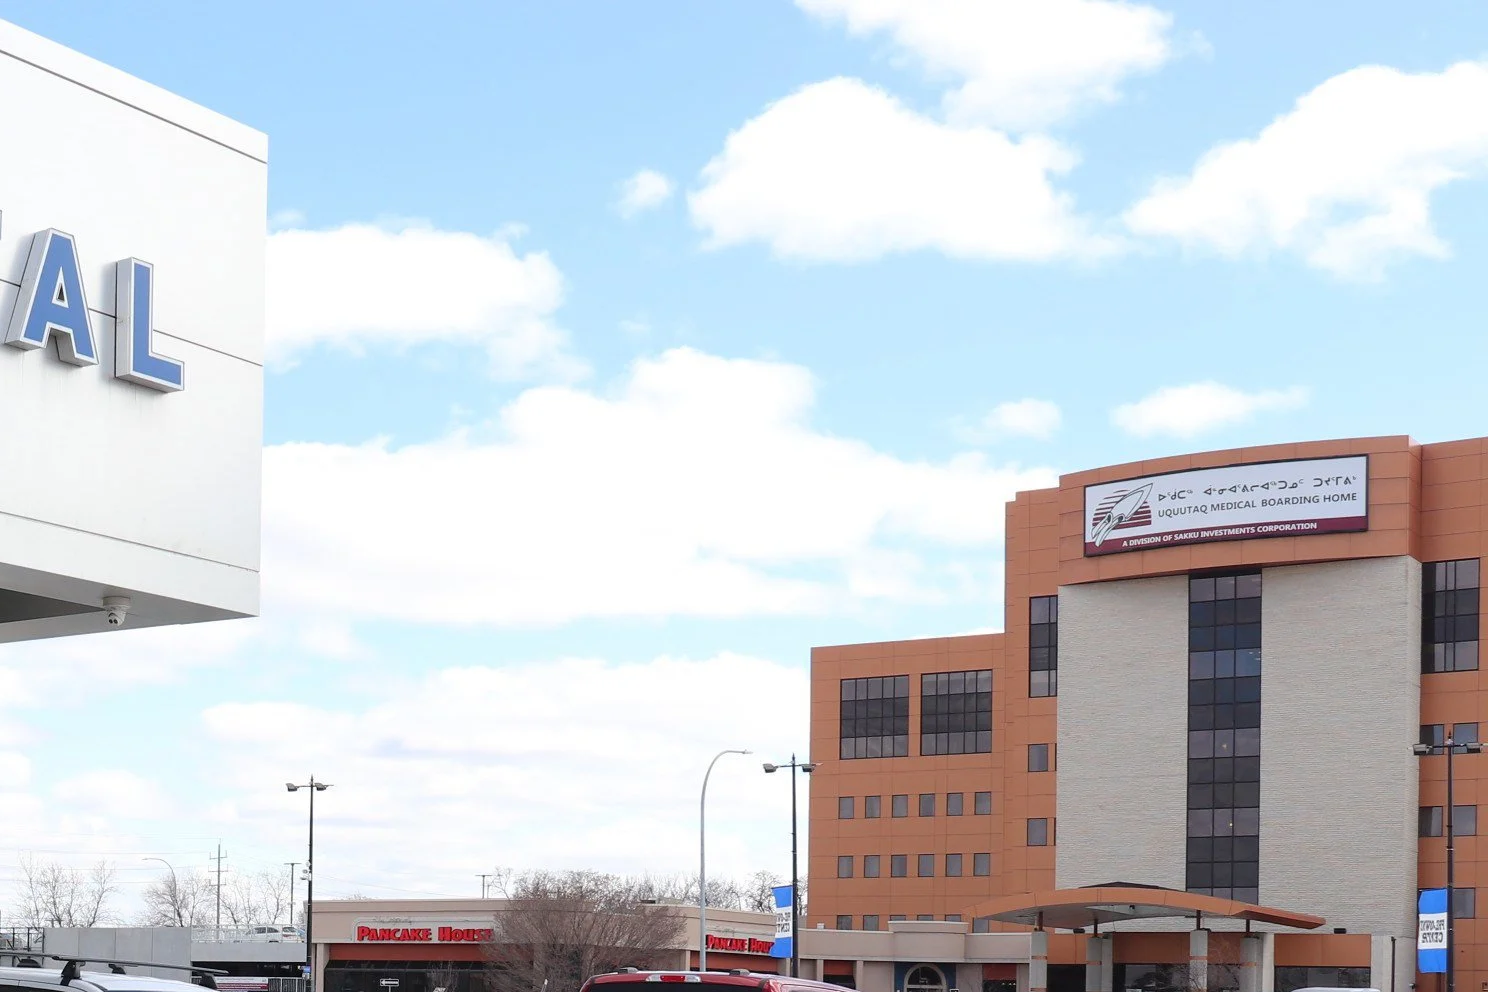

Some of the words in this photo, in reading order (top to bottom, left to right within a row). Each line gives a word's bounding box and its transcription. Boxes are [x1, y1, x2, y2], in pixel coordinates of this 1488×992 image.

[1158, 504, 1208, 518] UQUUTAQ
[1210, 500, 1257, 512] MEDICAL
[1261, 495, 1320, 507] BOARDING
[1323, 492, 1358, 503] HOME
[1129, 536, 1161, 546] DIVISION
[1162, 534, 1173, 542] OF
[1174, 531, 1200, 541] SAKKU
[1200, 526, 1256, 538] INVESTMENTS
[1256, 522, 1318, 533] CORPORATION
[356, 925, 432, 942] PANCAKE
[437, 926, 495, 942] HOUSE
[706, 934, 748, 952] PANCAKE
[748, 937, 775, 954] HOU
